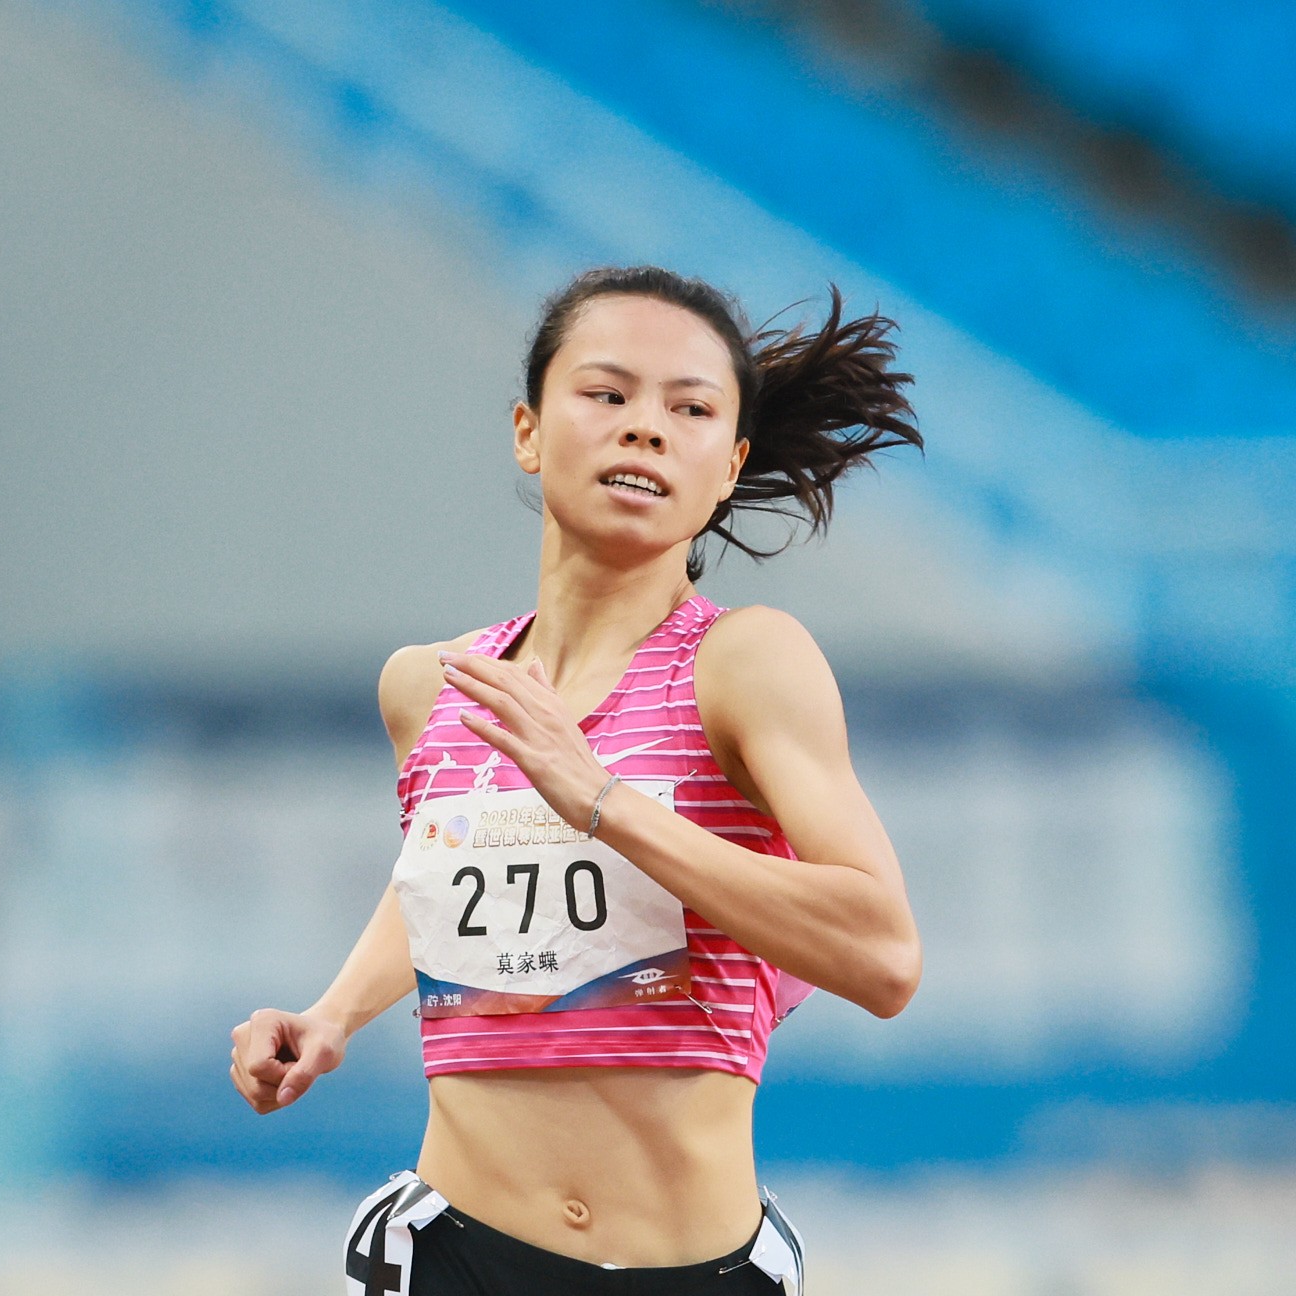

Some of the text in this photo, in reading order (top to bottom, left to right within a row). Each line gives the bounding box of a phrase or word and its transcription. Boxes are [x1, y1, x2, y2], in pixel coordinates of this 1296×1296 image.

[419, 750, 502, 803] 广东
[479, 804, 566, 827] 2023年全国
[451, 859, 608, 937] 270
[496, 950, 559, 975] 莫家蝶
